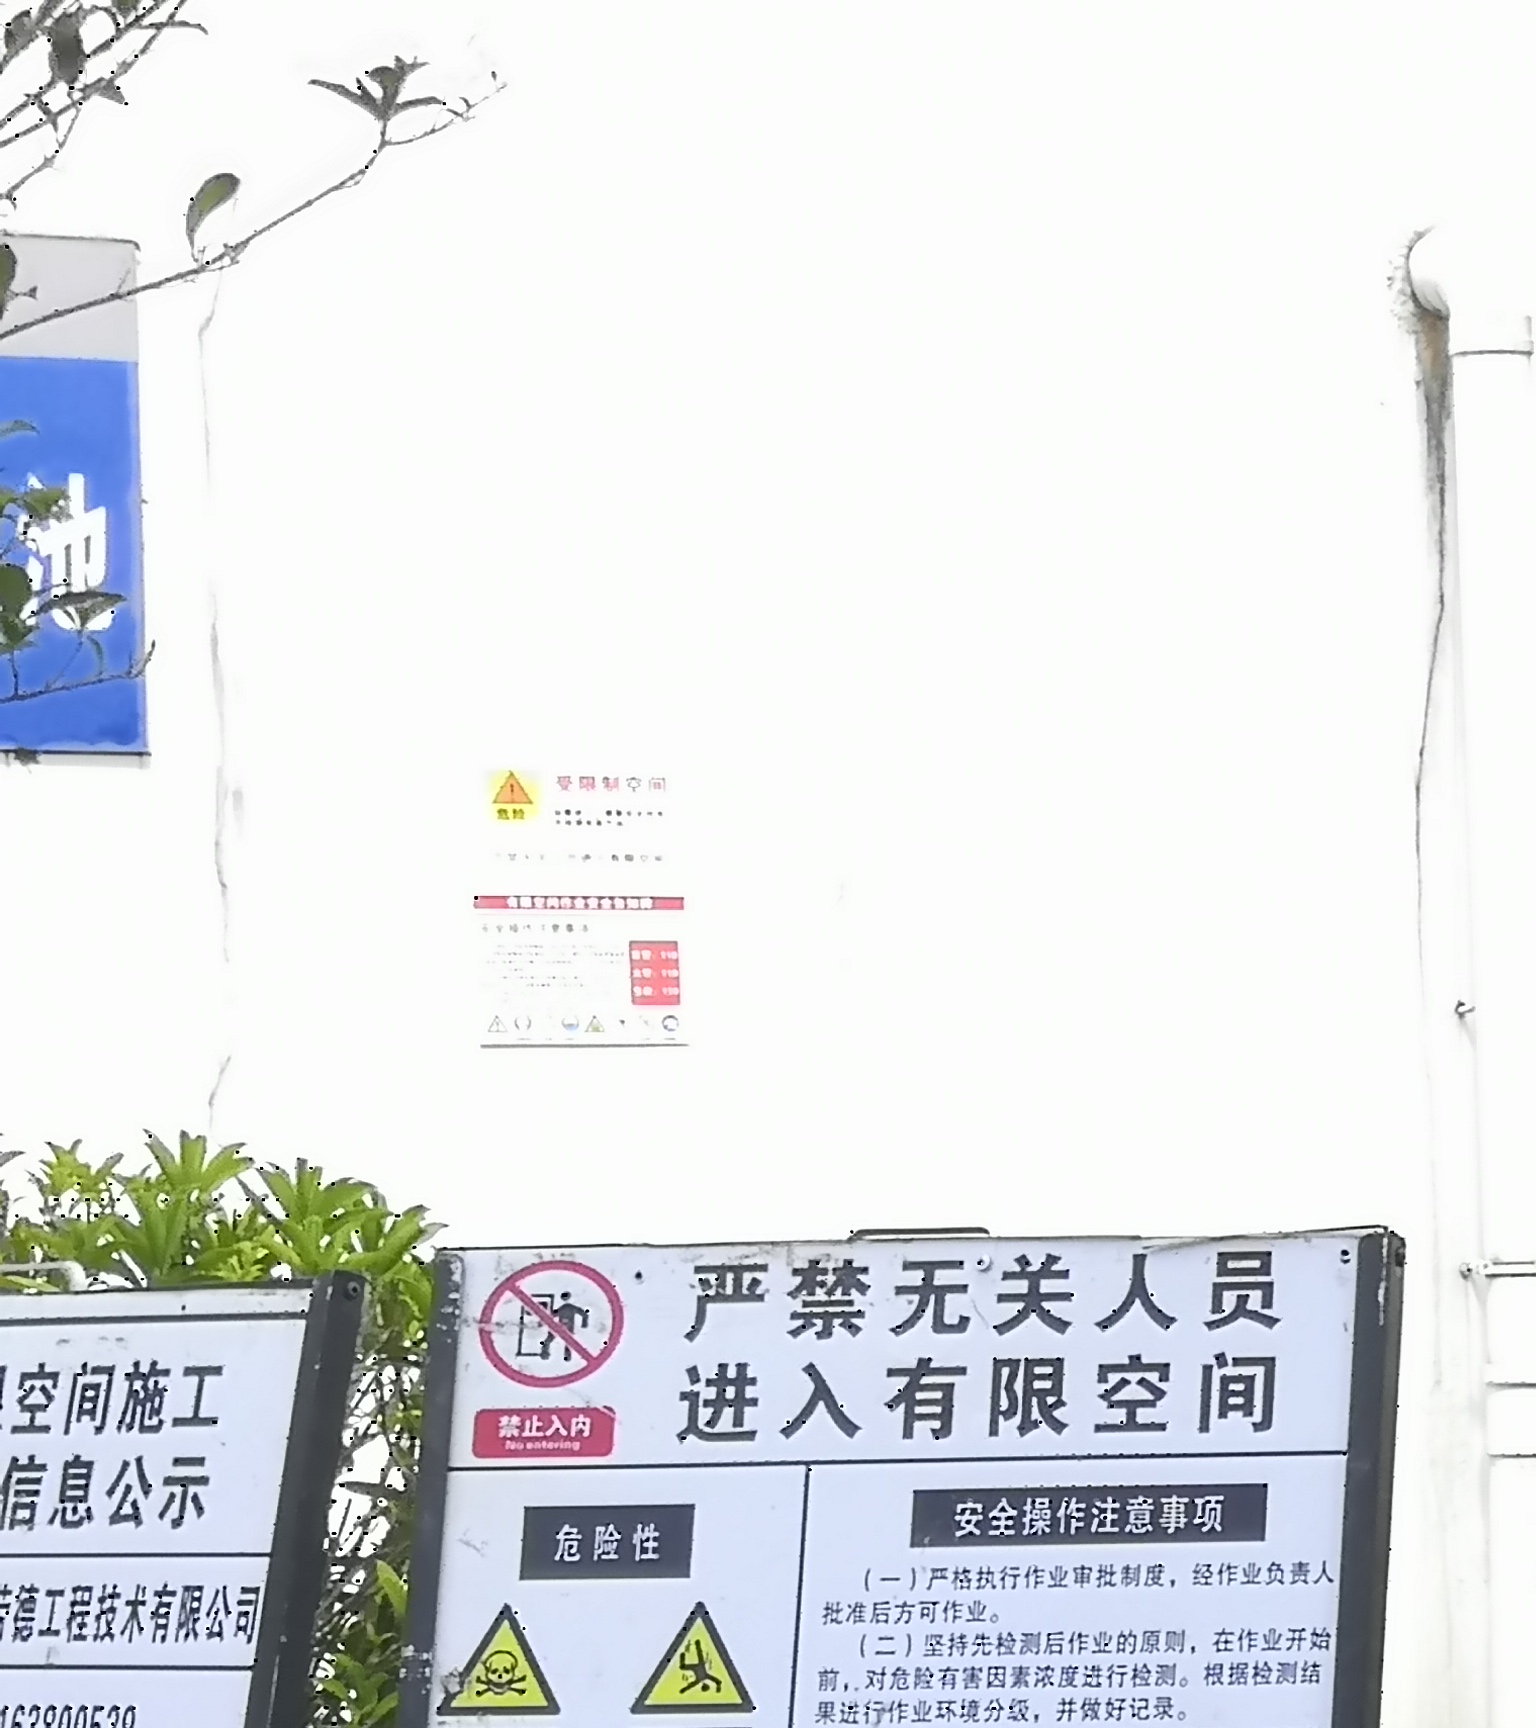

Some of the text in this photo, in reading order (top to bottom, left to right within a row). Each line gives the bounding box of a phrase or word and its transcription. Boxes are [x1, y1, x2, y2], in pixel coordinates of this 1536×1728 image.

[683, 1250, 1282, 1342] 严禁无关人员
[0, 1361, 224, 1436] 空间施工
[678, 1354, 1276, 1445] 进入有限空间
[498, 1414, 591, 1438] 禁止入内
[505, 1440, 581, 1451] No entering
[0, 1454, 212, 1531] 信息公示
[954, 1494, 1225, 1538] 安全操作注意事项
[554, 1523, 660, 1562] 危险性
[822, 1601, 1001, 1626] 批准后方可作业。
